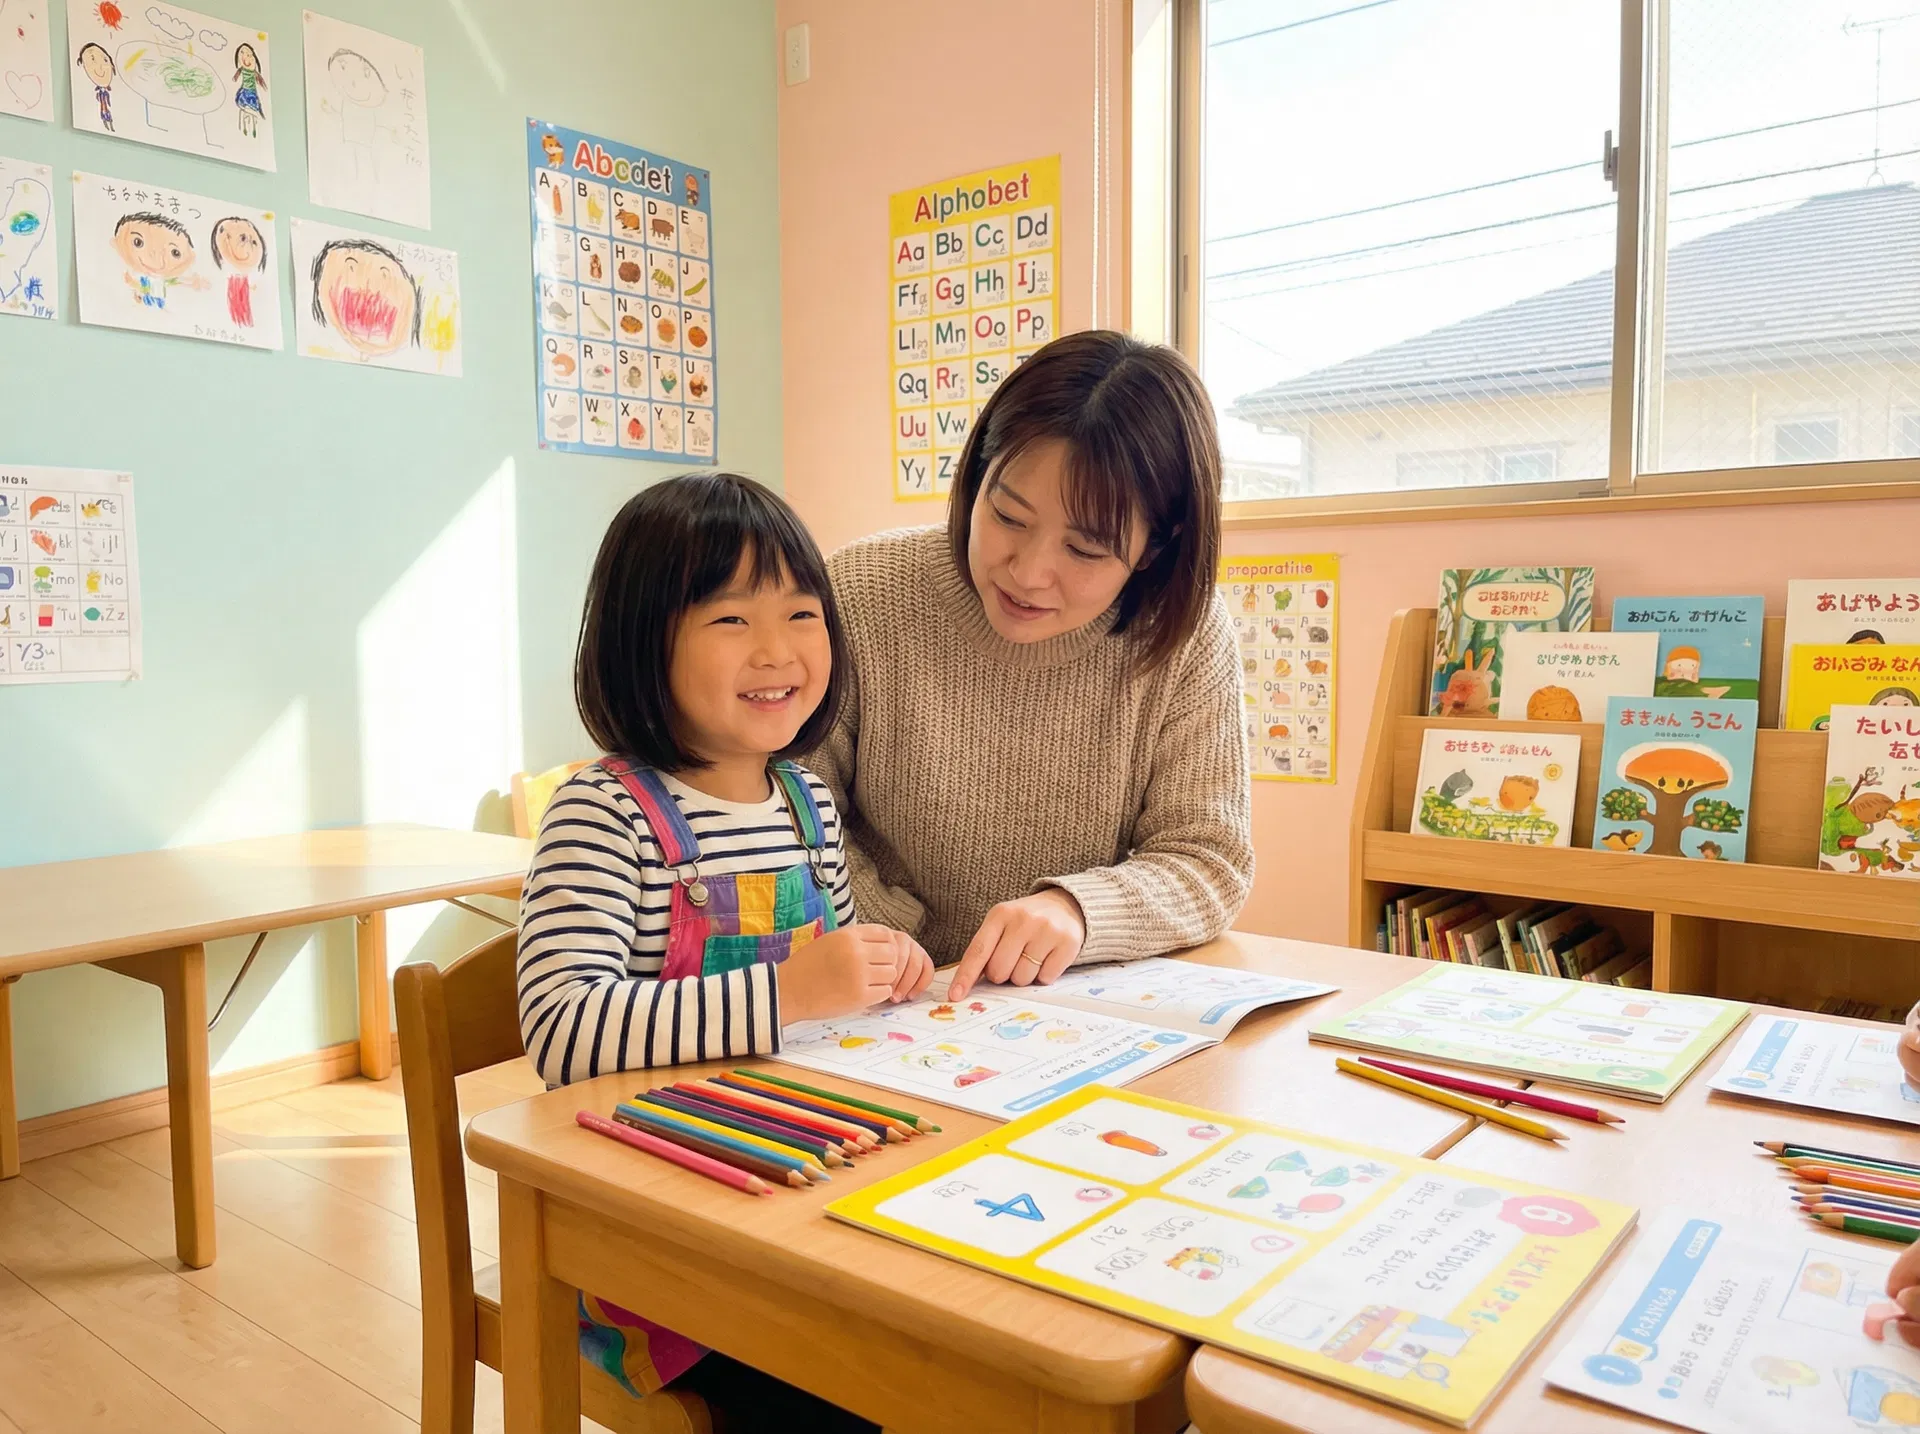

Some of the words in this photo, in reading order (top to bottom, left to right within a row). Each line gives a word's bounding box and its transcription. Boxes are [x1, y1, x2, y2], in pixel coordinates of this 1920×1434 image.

[573, 141, 671, 195] Abcdet
[539, 172, 550, 188] A
[578, 182, 588, 197] B
[613, 192, 624, 207] C
[647, 201, 657, 215] D
[681, 210, 689, 225] E
[580, 237, 591, 252] G
[615, 245, 626, 260] H
[682, 262, 689, 275] J
[897, 241, 925, 264] Aa
[936, 232, 963, 256] Bb
[975, 223, 1004, 247] Cc
[1017, 213, 1048, 240] Dd
[899, 283, 918, 307] Ff
[936, 277, 965, 305] Gg
[975, 269, 1004, 294] Hh
[582, 291, 591, 306] L
[617, 298, 628, 312] N
[651, 305, 662, 319] O
[684, 311, 693, 323] P
[936, 321, 966, 345] Mn
[975, 315, 1006, 338] Oo
[1017, 308, 1044, 339] Pp
[546, 338, 559, 355] Q
[583, 344, 593, 359] R
[619, 350, 629, 365] S
[652, 356, 661, 369] T
[685, 361, 695, 374] U
[899, 373, 928, 398] Qq
[936, 367, 958, 389] Rr
[975, 361, 1000, 384] Ss
[547, 394, 557, 408] V
[585, 398, 599, 412] W
[620, 402, 630, 417] X
[654, 407, 663, 420] Y
[687, 411, 696, 424] Z
[900, 415, 926, 437] Uu
[937, 411, 966, 434] Vw
[901, 458, 925, 488] Yy
